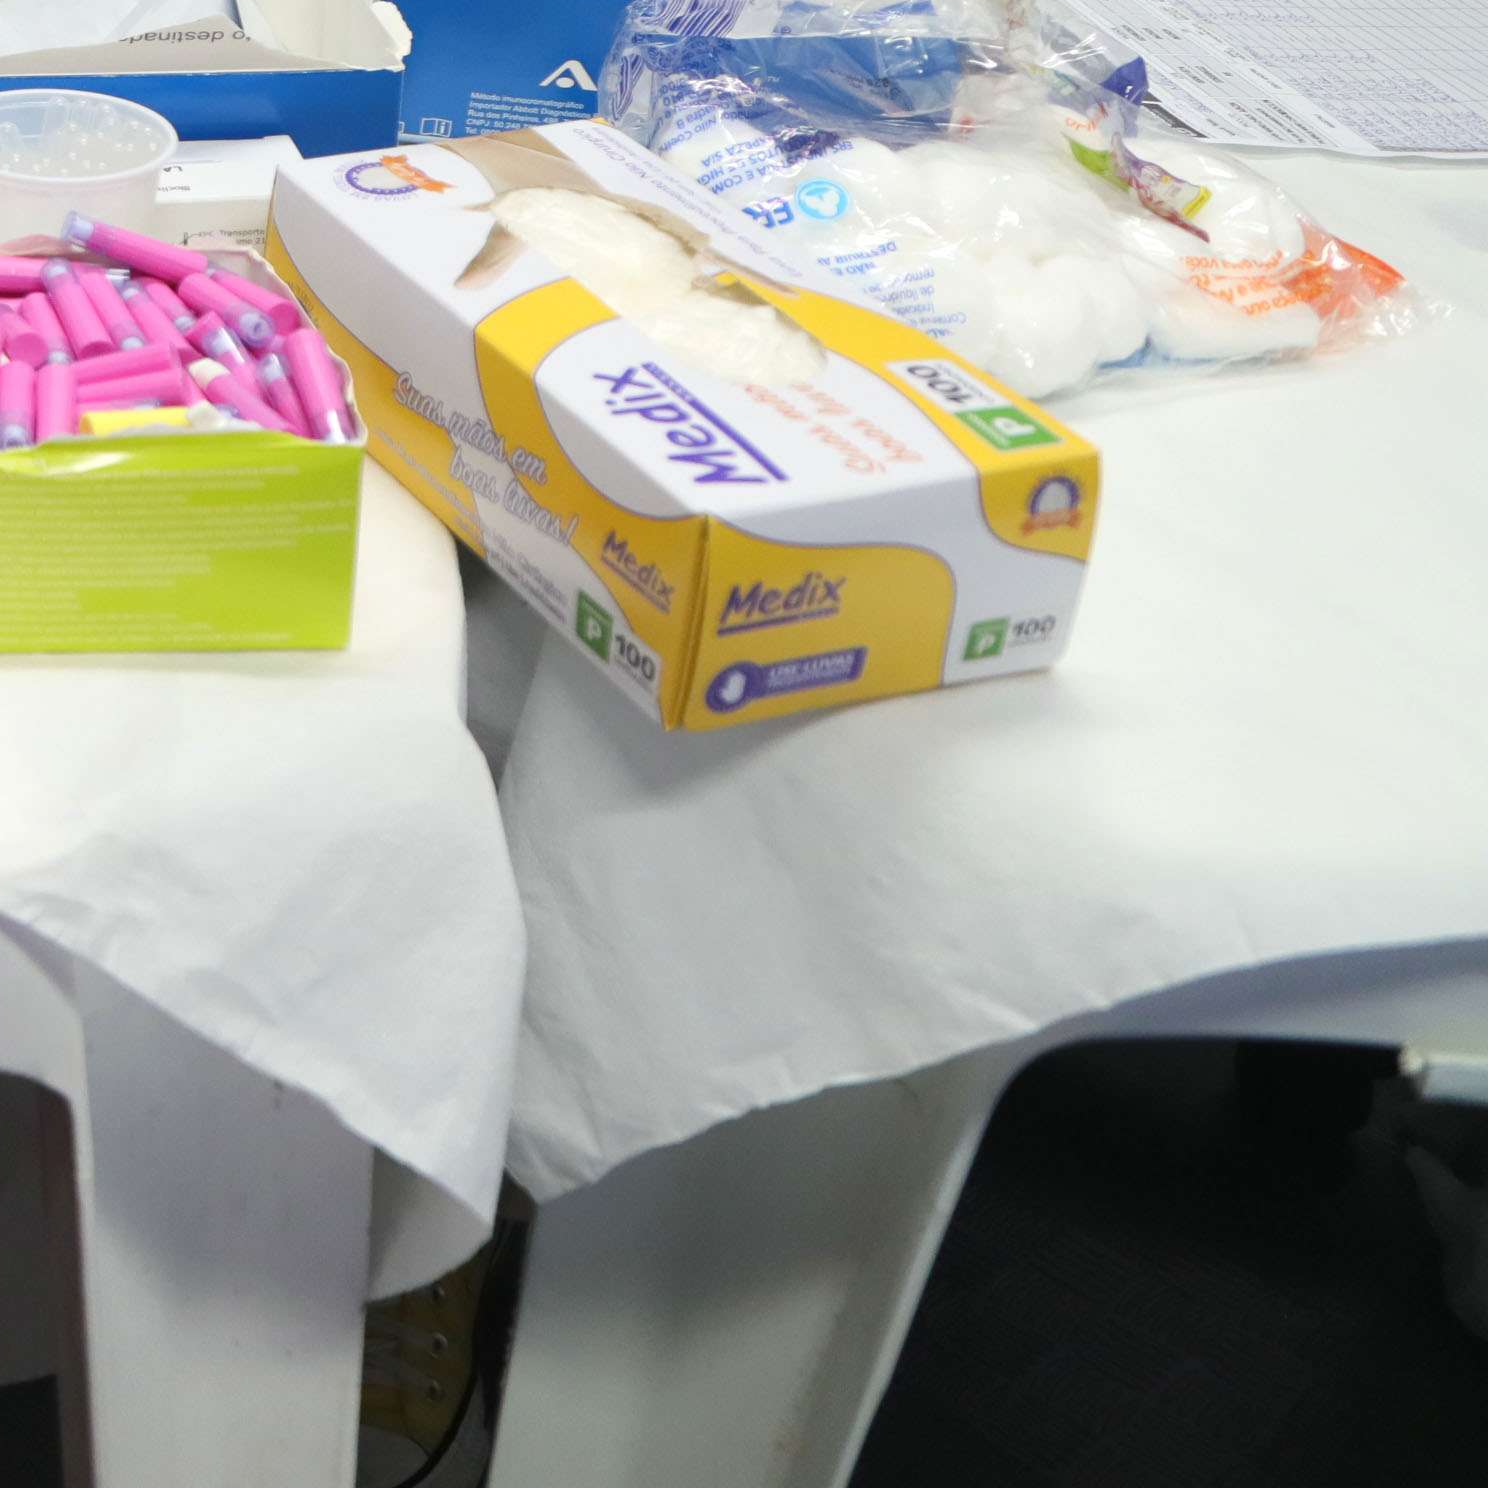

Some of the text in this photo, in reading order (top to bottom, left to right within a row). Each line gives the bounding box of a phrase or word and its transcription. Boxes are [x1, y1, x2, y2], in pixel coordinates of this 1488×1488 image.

[907, 365, 971, 403] 100
[396, 372, 446, 428] Suas
[449, 412, 508, 462] mãos
[512, 448, 548, 486] em
[593, 366, 769, 484] Medix
[449, 446, 499, 503] boas
[504, 478, 579, 546] luvas!
[602, 530, 674, 607] Medix
[720, 571, 846, 624] Medix
[615, 634, 655, 682] 100
[1012, 615, 1056, 638] 100
